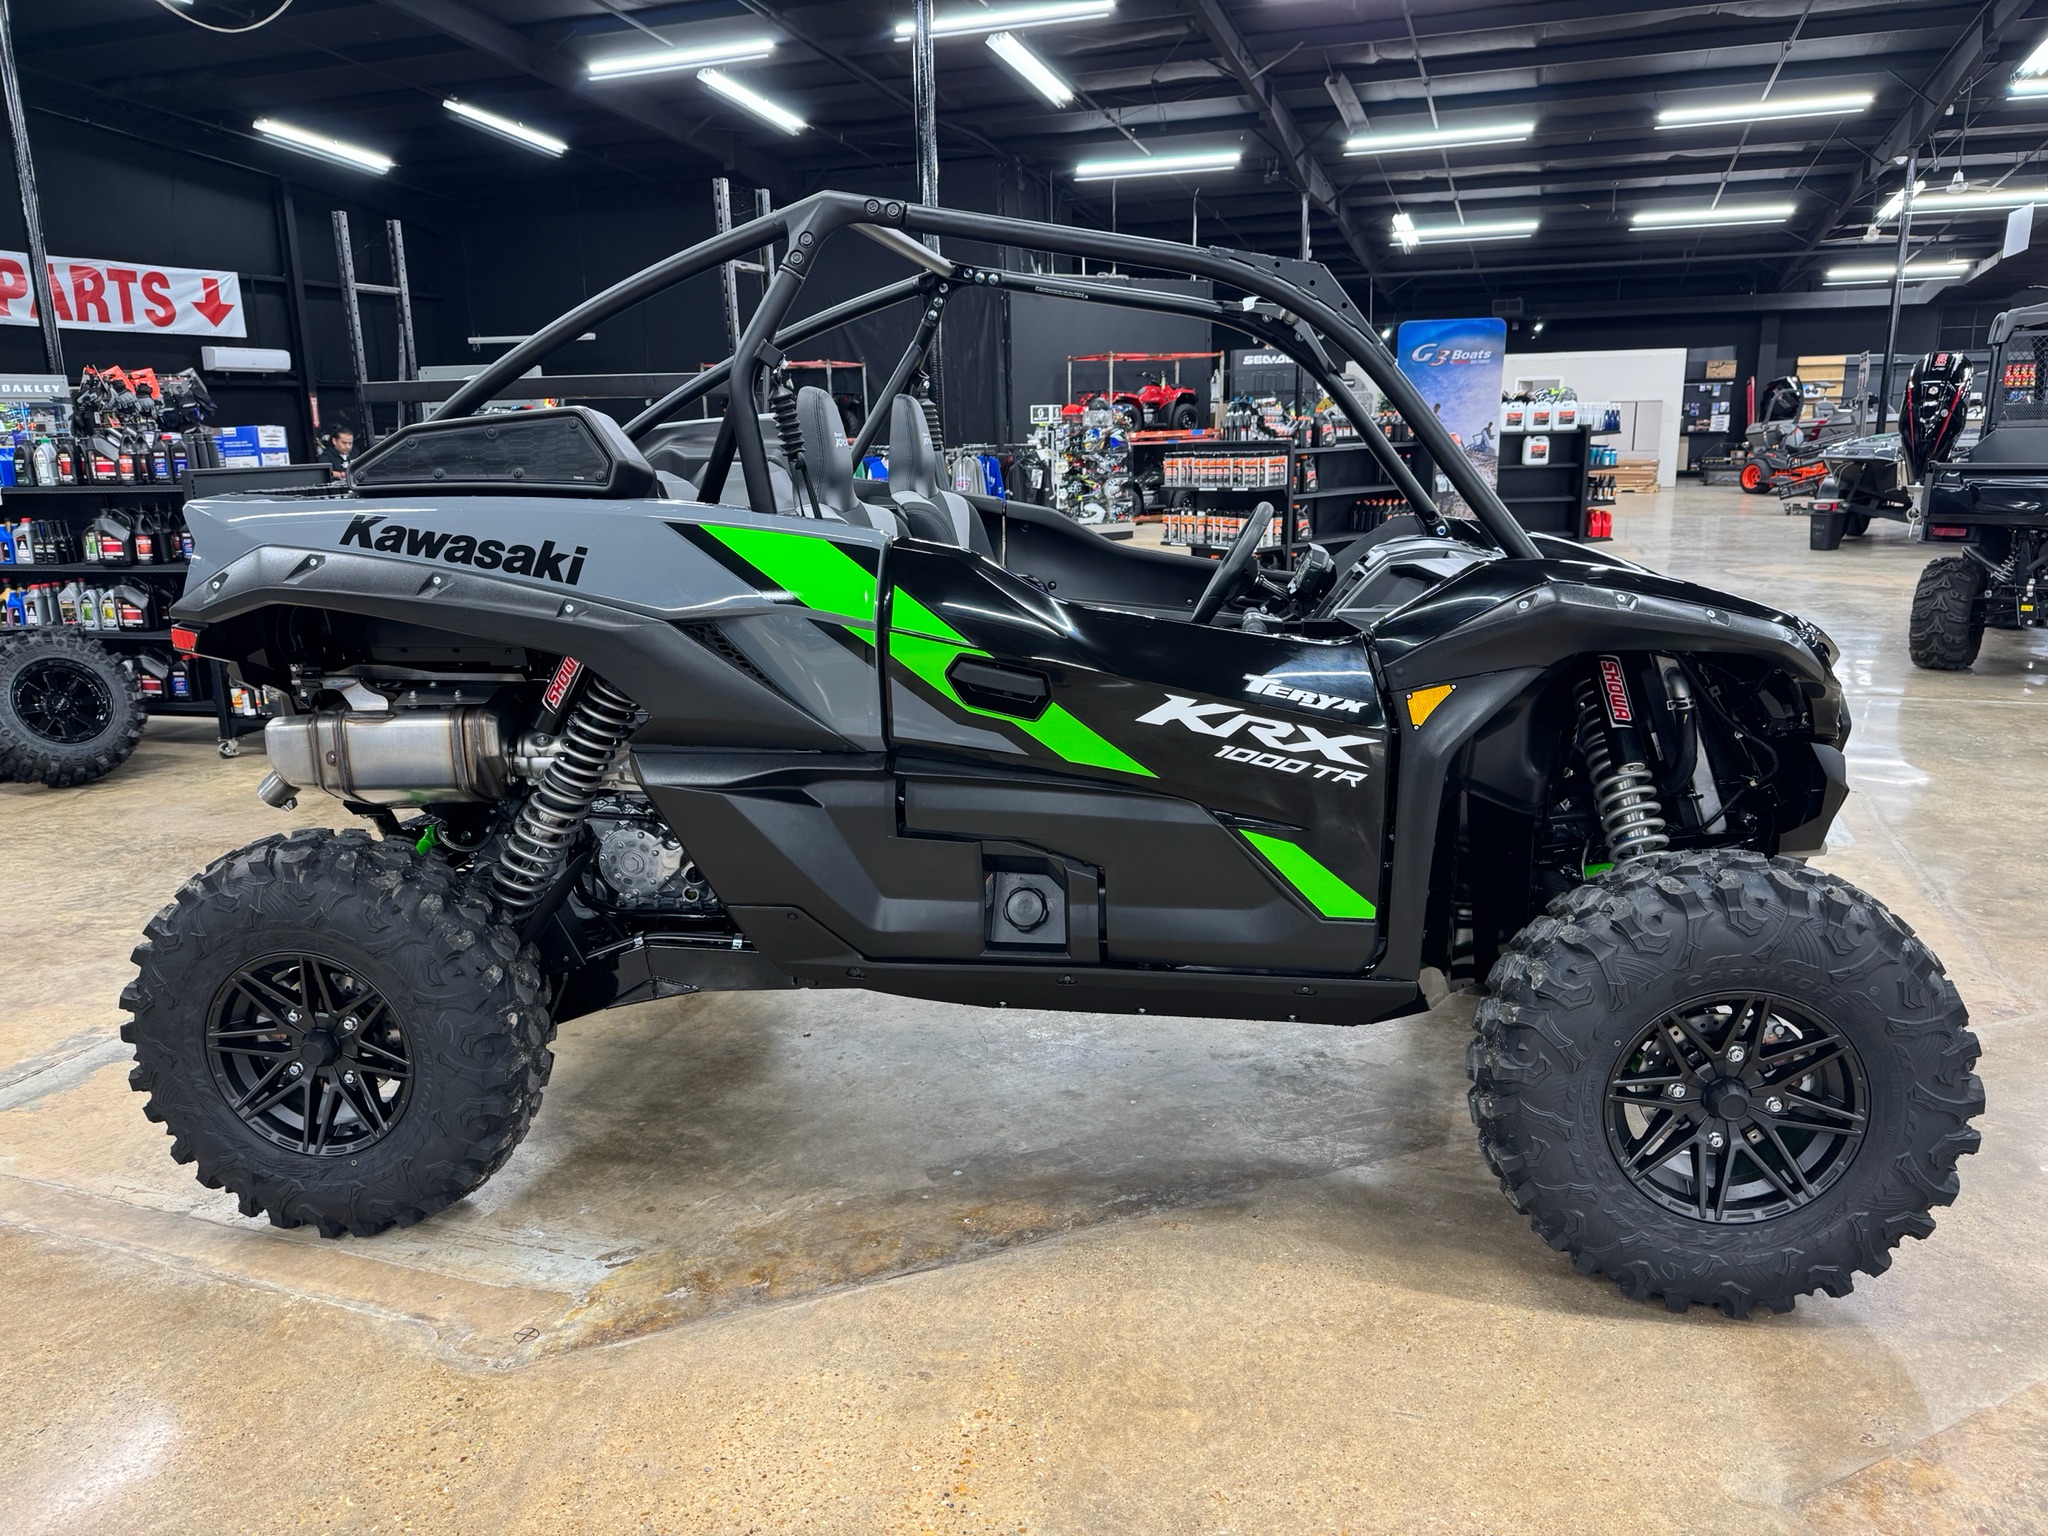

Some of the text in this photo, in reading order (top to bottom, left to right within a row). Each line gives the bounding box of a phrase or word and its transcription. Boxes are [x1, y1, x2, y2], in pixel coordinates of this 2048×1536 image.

[1411, 343, 1492, 366] G3 Boats
[1, 384, 60, 393] OAKLEY
[339, 513, 589, 586] Kawasaki
[547, 655, 581, 709] SHOW
[1600, 660, 1632, 721] SHOWA
[1135, 693, 1382, 768] KRX
[1214, 745, 1368, 787] 1000 TR
